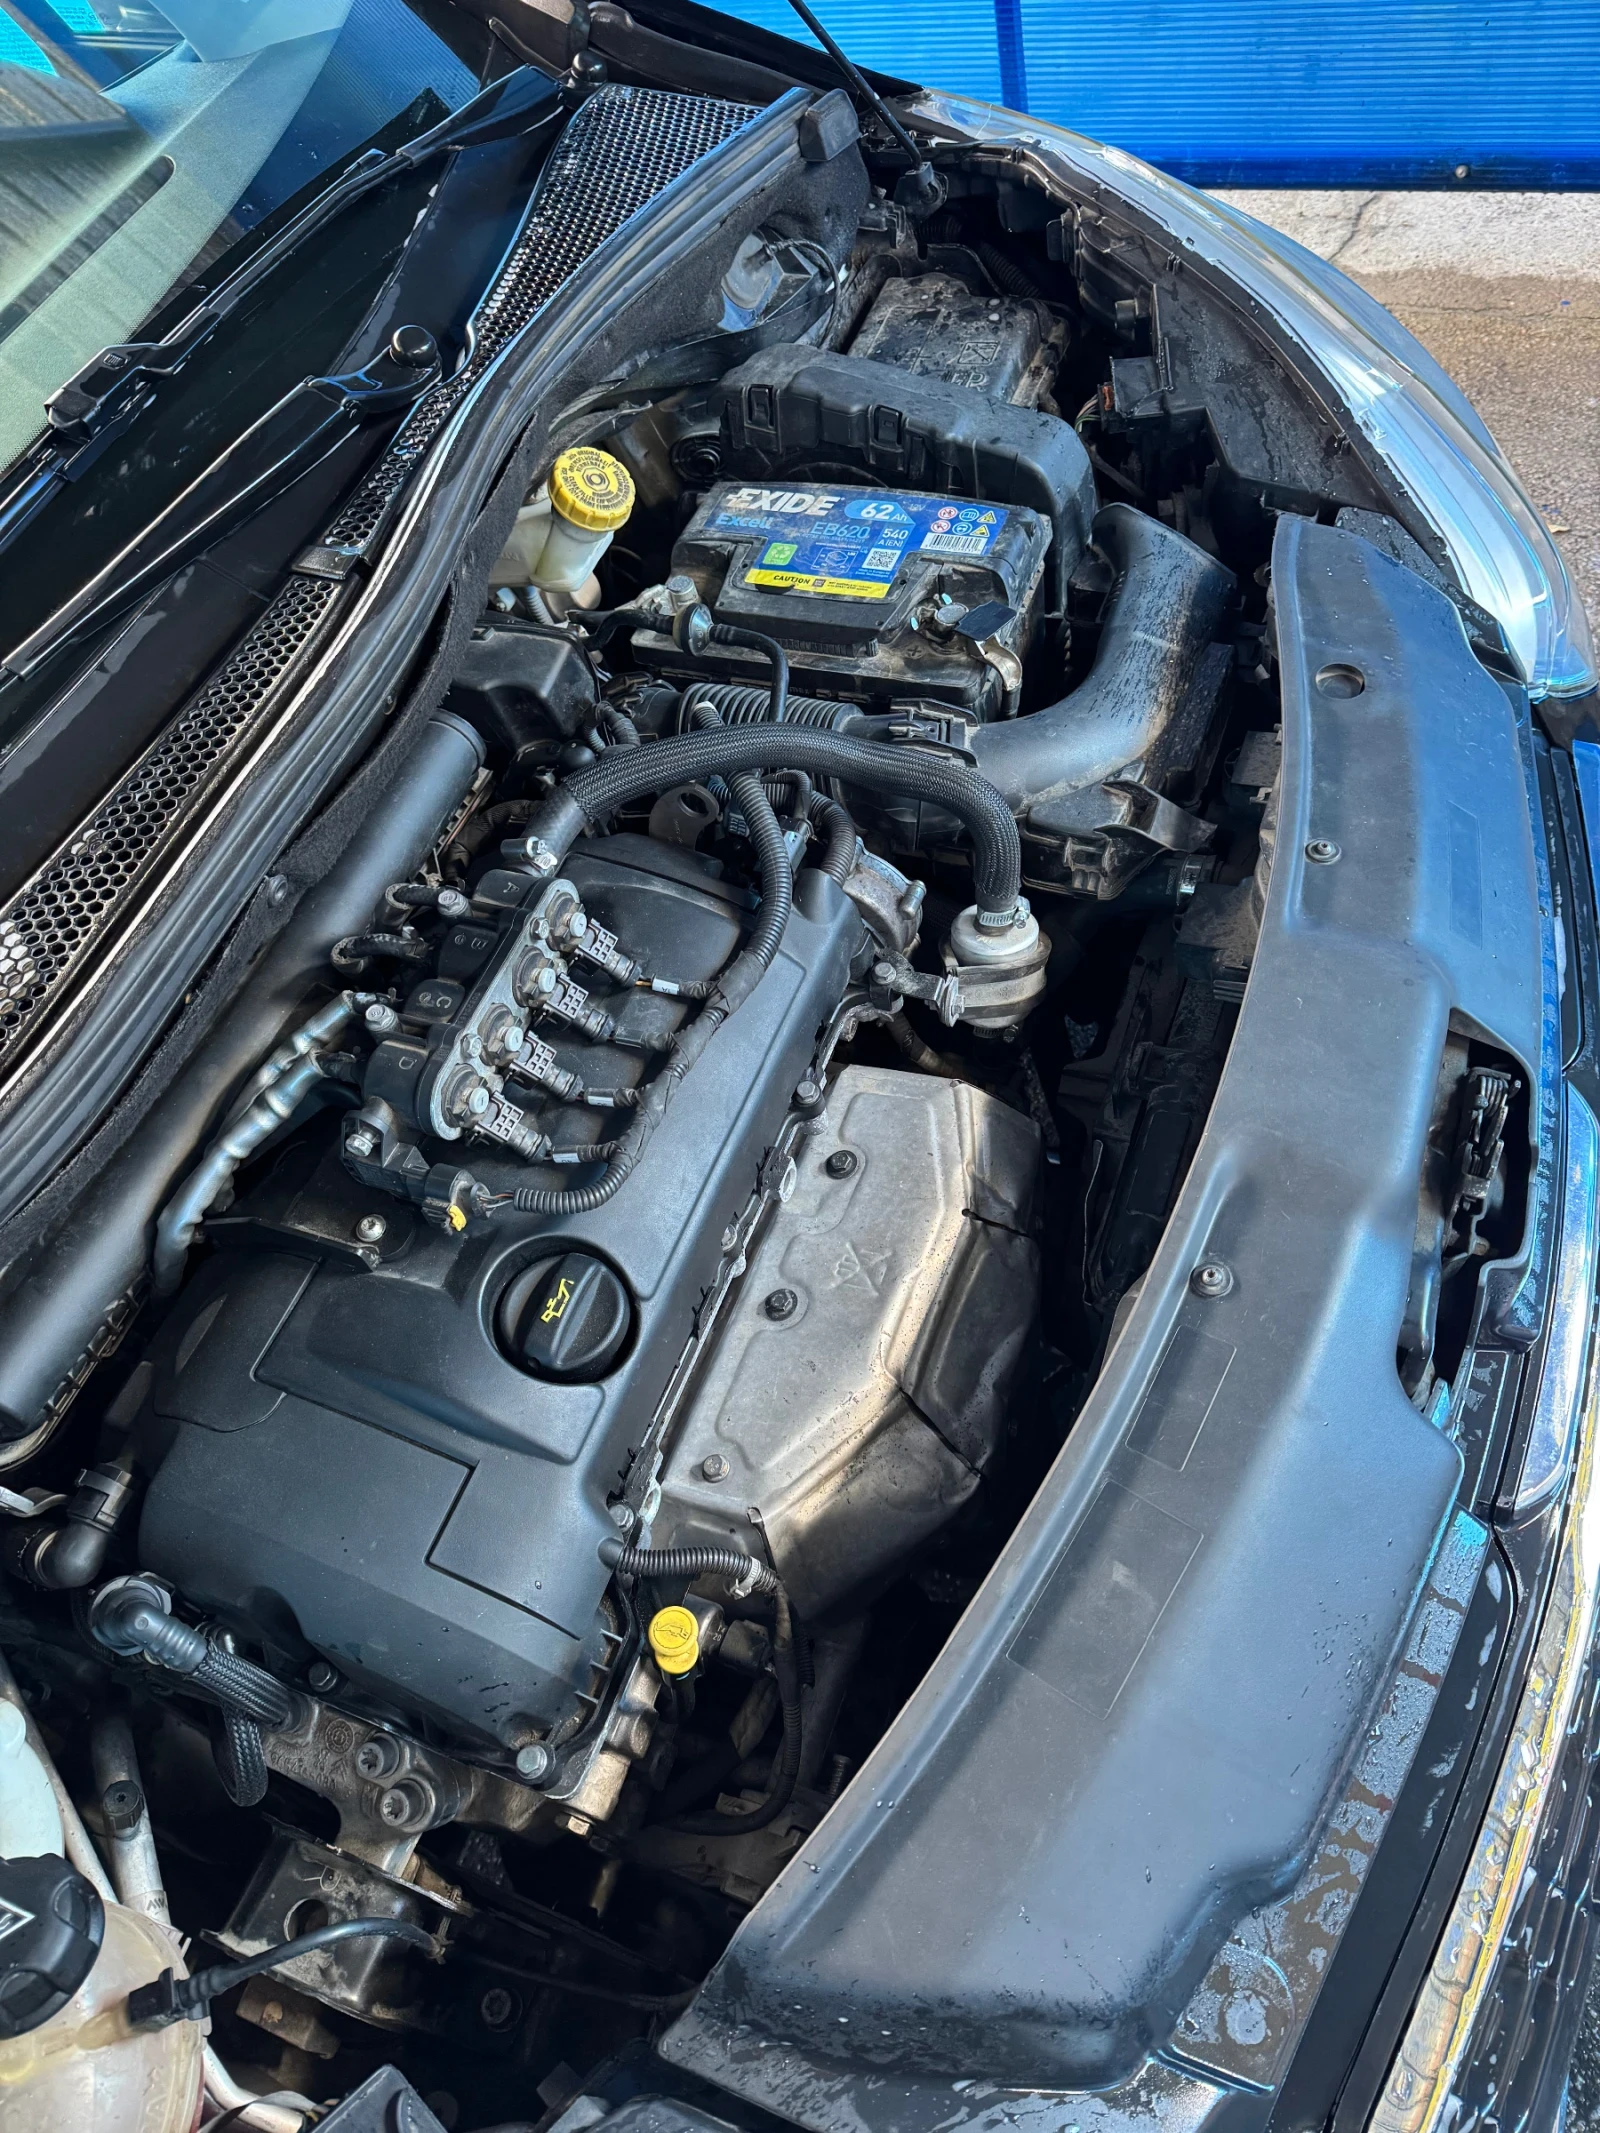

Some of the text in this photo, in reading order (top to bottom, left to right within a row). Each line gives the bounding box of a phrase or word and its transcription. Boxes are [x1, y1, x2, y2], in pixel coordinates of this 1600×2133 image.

[725, 488, 841, 516] EXIDE
[860, 502, 908, 521] 62 Ah
[715, 512, 774, 530] Excell
[811, 521, 871, 539] EB620
[882, 528, 909, 540] 540
[773, 574, 811, 585] CAUTION
[502, 881, 520, 893] A
[436, 995, 453, 1009] C
[398, 1055, 418, 1070] D
